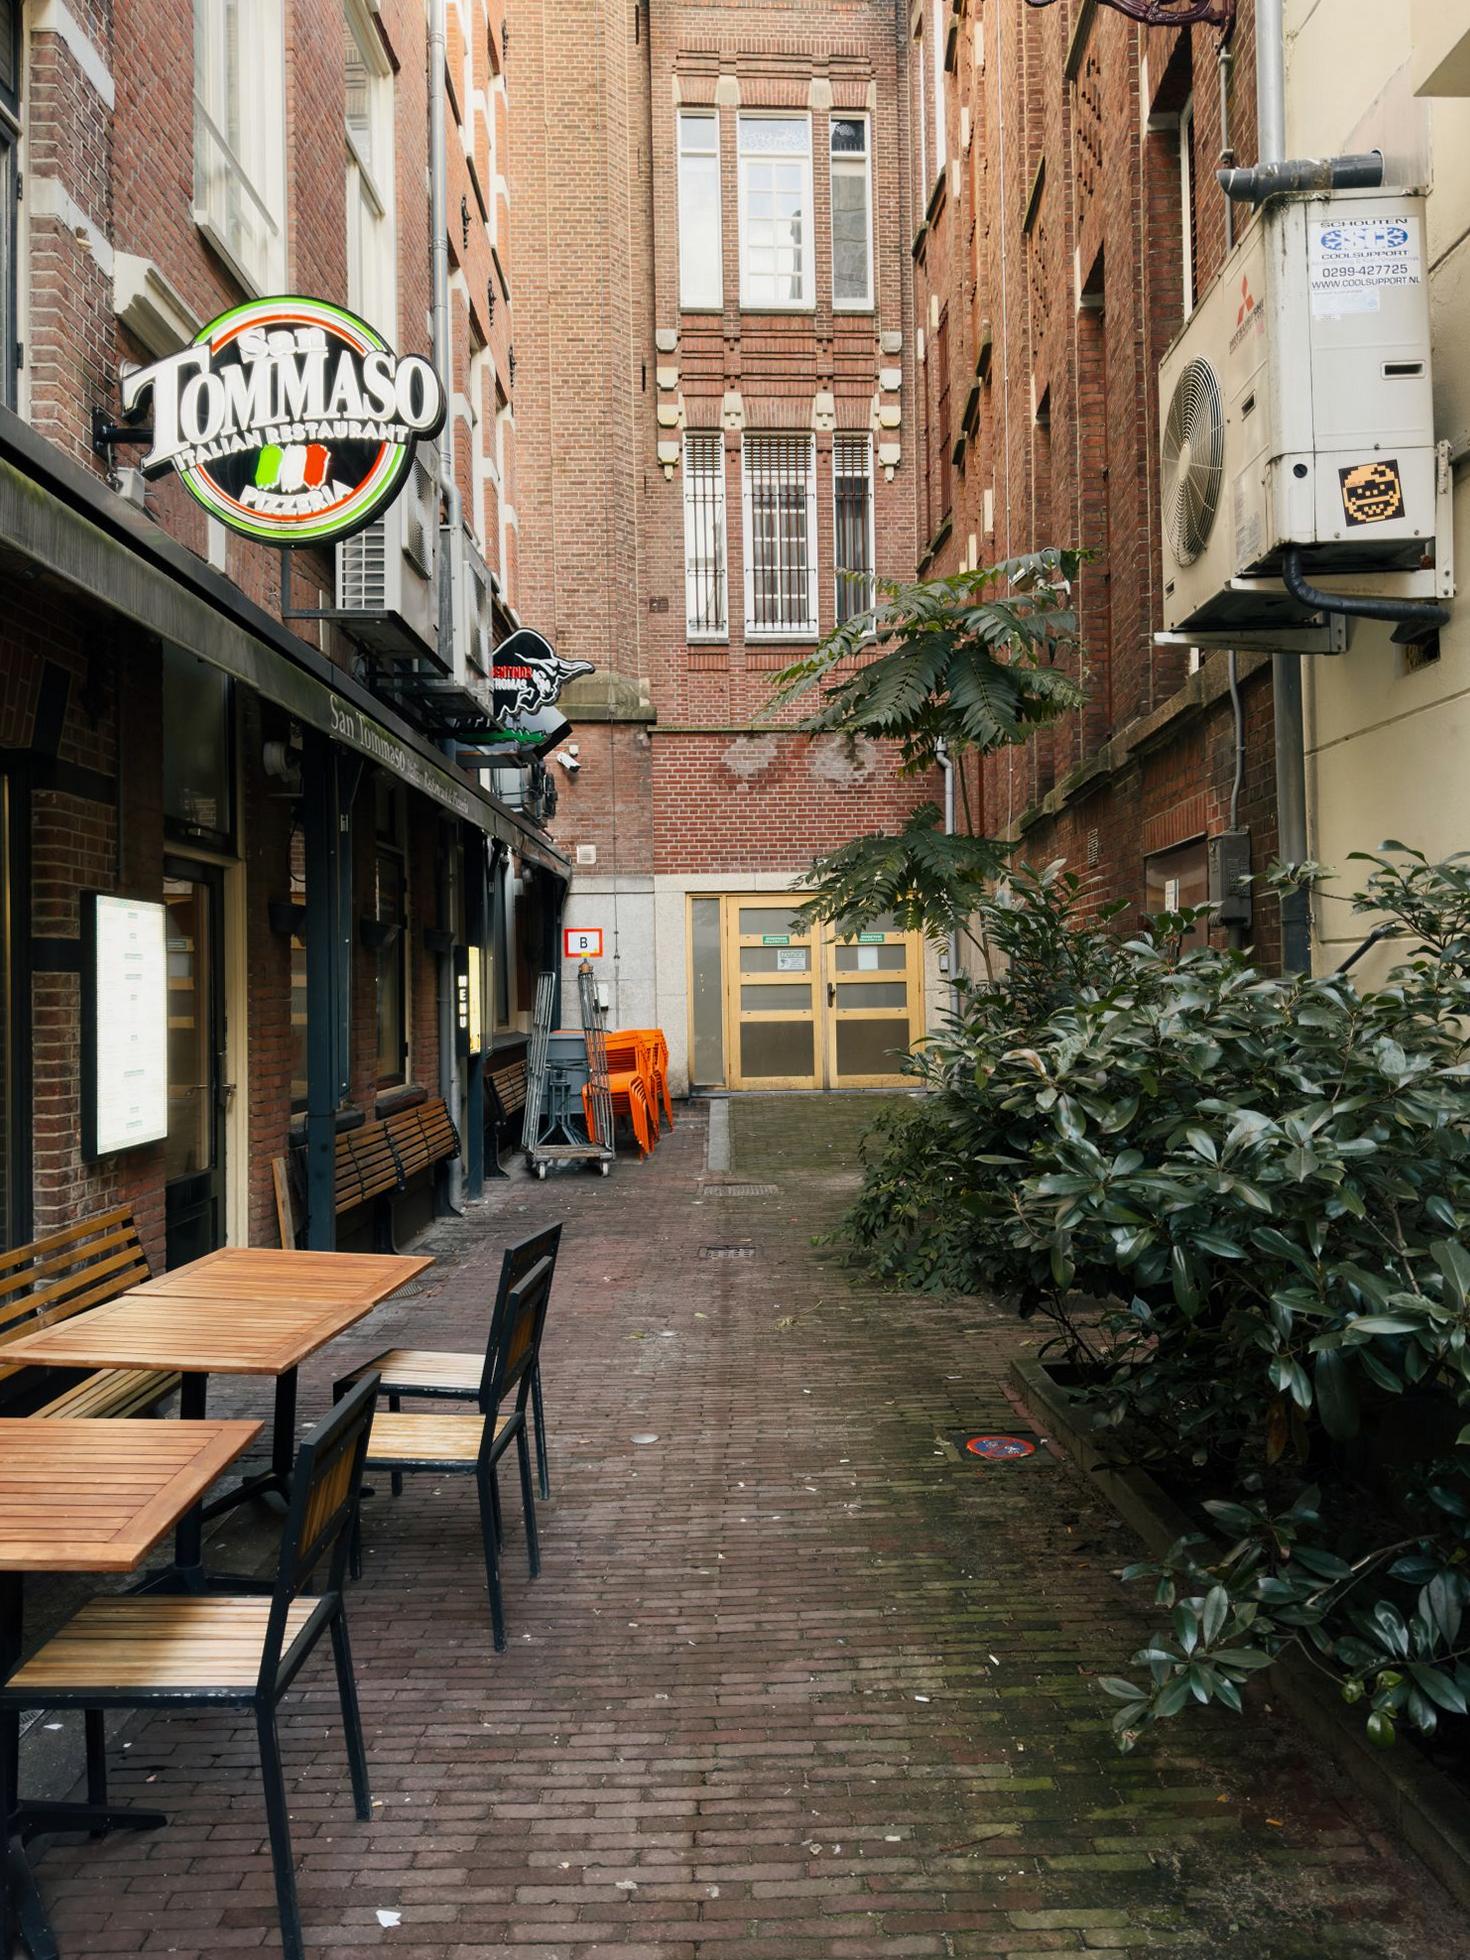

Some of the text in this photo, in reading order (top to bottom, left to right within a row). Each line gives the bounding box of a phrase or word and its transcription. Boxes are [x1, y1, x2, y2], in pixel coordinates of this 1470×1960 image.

[1320, 218, 1408, 228] SCHOUTEN
[1321, 250, 1408, 260] COOLSUPPORT
[1322, 264, 1408, 278] 0299-427725
[237, 328, 329, 363] San
[122, 343, 440, 470] TOMMASO
[174, 421, 409, 471] ITALIAN RESTAURANT
[239, 479, 355, 516] PIZZERIA
[330, 694, 355, 739] San
[356, 711, 406, 772] Tommaso
[579, 936, 588, 949] B
[458, 975, 467, 1029] MENU
